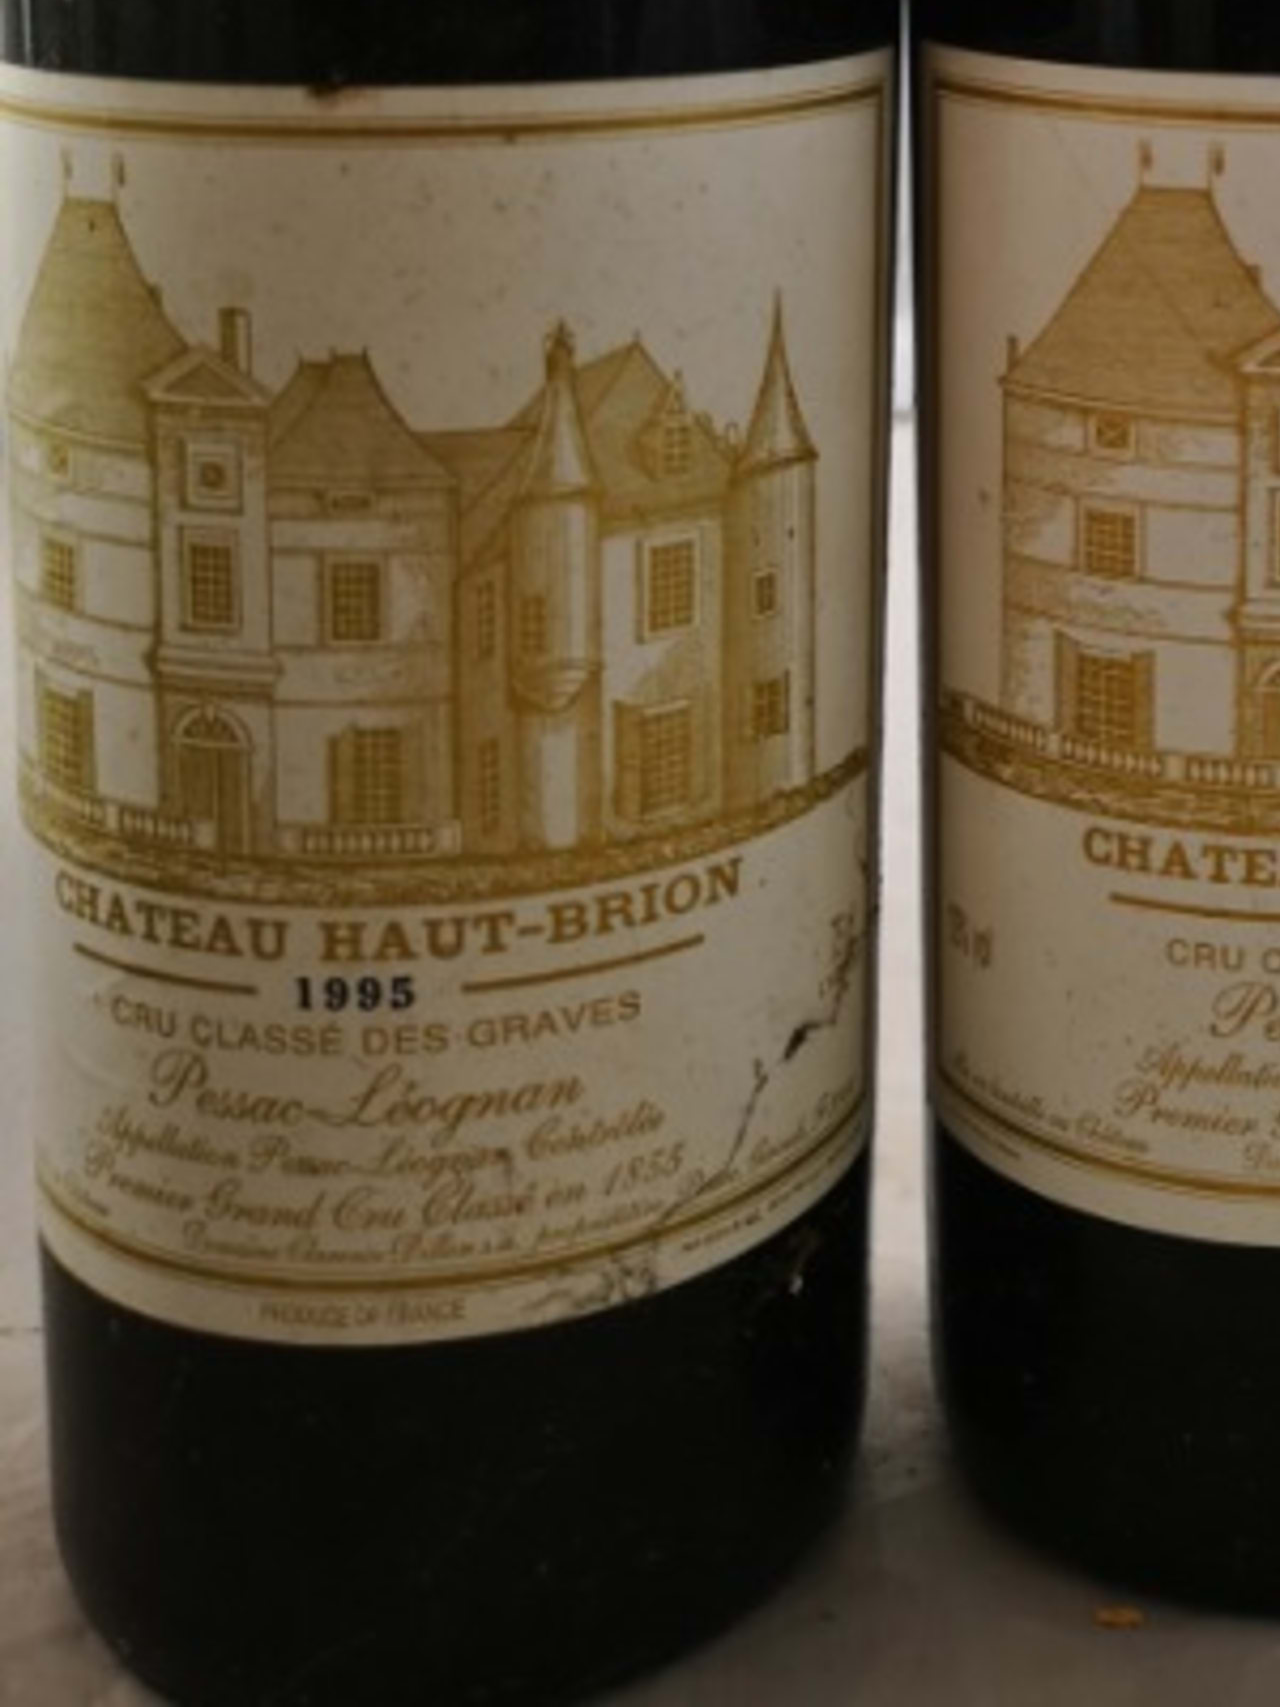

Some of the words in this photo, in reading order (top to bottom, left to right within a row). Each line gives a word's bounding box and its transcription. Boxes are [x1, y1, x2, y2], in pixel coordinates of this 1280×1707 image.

[54, 868, 291, 962] CHATEAU
[318, 856, 745, 963] HAUT-BRION
[1165, 938, 1246, 972] CRU
[294, 975, 417, 1013] 1995
[109, 994, 177, 1039] CRU
[189, 1015, 344, 1057] CLASSÉ
[360, 1022, 450, 1057] DES
[466, 990, 644, 1050] GRAVES
[604, 1141, 686, 1198] 1855
